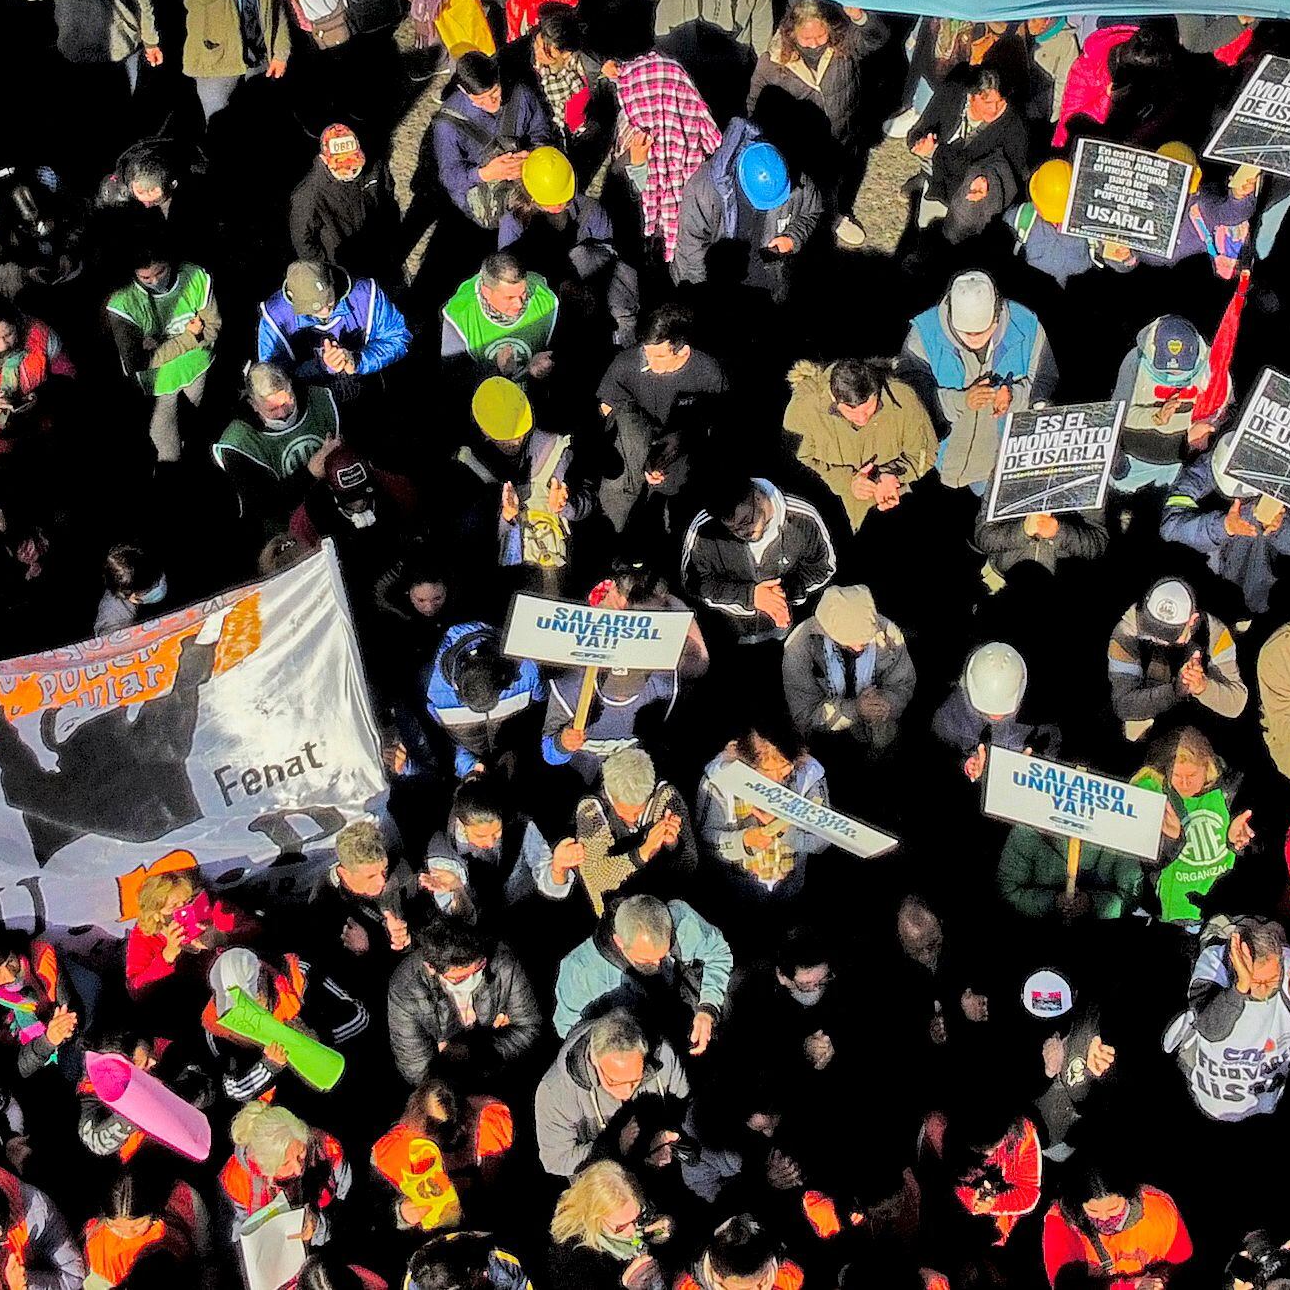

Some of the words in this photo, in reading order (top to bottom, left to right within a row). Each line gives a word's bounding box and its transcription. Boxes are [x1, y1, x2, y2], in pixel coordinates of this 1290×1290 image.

[1241, 97, 1268, 113] DE
[334, 140, 354, 152] OBEY
[1093, 163, 1103, 172] el
[1104, 165, 1135, 181] mejor
[1108, 175, 1133, 188] para
[1133, 179, 1149, 190] los
[1094, 189, 1154, 211] POPULARES
[1103, 183, 1149, 200] sectores
[1086, 204, 1155, 235] USARLA
[1035, 414, 1062, 434] ES
[1064, 413, 1088, 430] EL
[1247, 414, 1277, 439] DE
[1006, 427, 1112, 456] MOMENTO
[1004, 453, 1029, 470] DE
[1030, 445, 1106, 466] USARLA
[537, 616, 662, 640] UNIVERSAL
[554, 606, 652, 628] SALARIO
[575, 634, 619, 649] YA!!
[212, 740, 324, 808] Fenat
[1028, 762, 1126, 801] SALARIO
[1013, 771, 1138, 819] UNIVERSAL
[1051, 796, 1095, 820] YA!!
